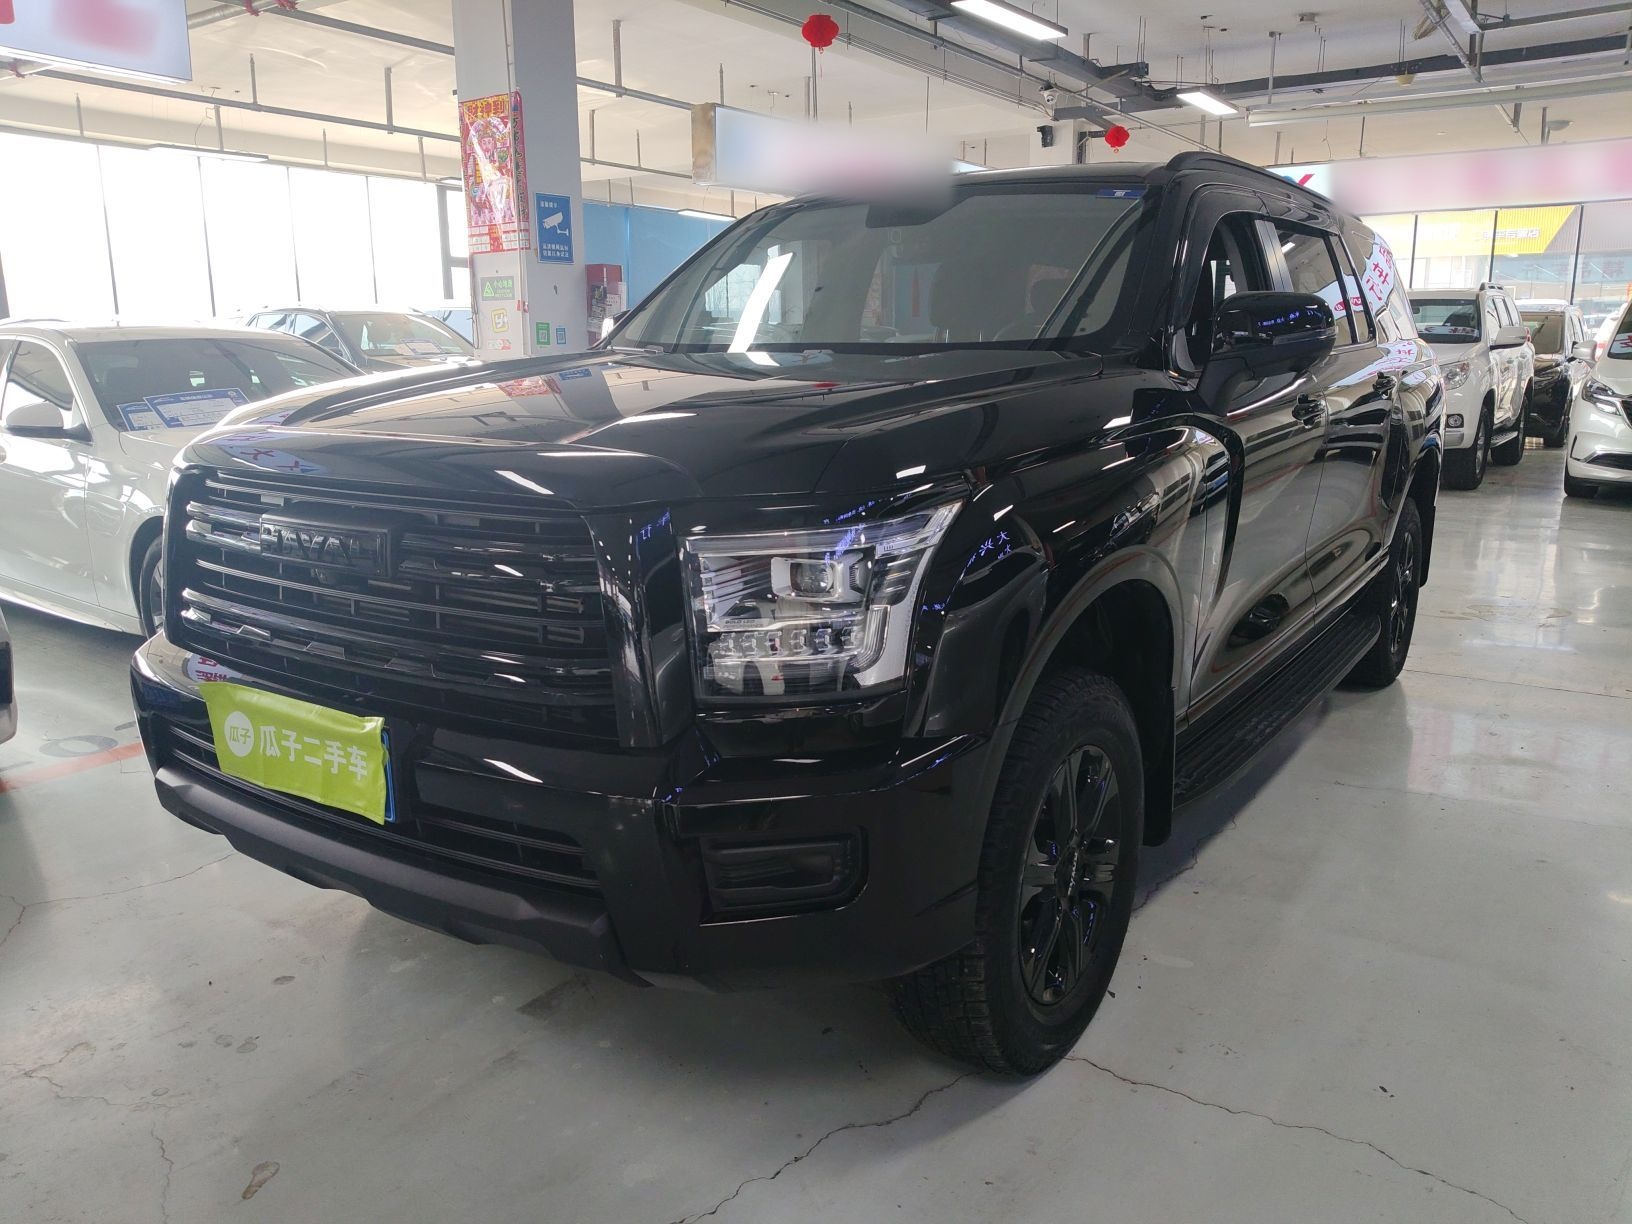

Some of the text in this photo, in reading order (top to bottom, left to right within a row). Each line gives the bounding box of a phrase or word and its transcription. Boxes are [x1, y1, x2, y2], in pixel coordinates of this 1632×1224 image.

[229, 726, 251, 744] 瓜子
[259, 725, 368, 781] 瓜子二手车
